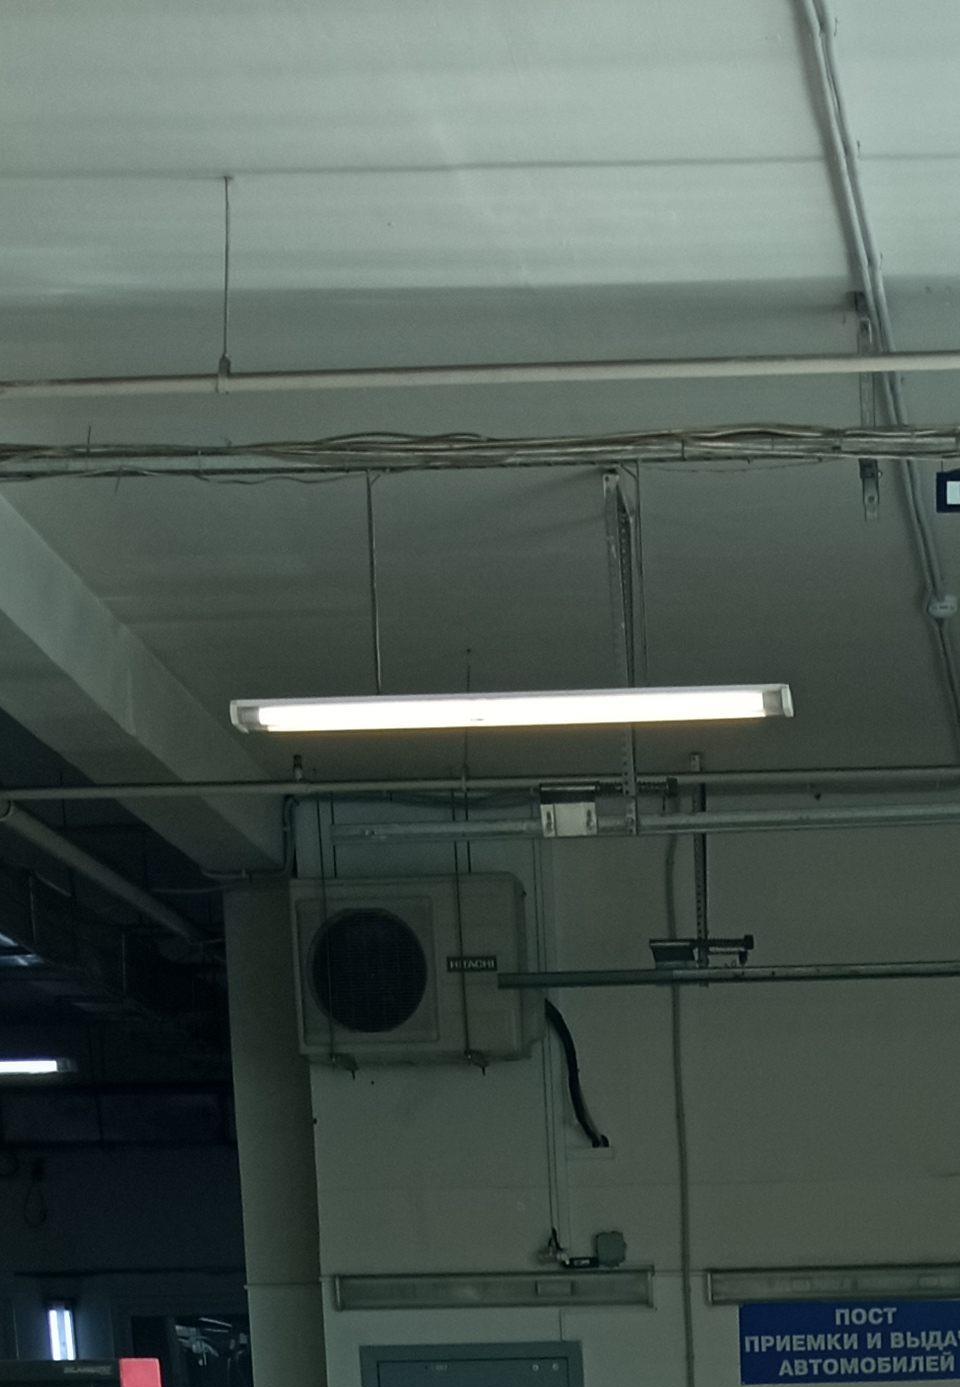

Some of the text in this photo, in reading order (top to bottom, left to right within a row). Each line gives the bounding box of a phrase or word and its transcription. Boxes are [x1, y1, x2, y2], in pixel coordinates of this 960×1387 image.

[835, 1307, 897, 1326] ПОСТ
[745, 1333, 858, 1352] ПРИЕМКИ
[867, 1332, 882, 1349] И
[778, 1351, 955, 1377] АВТОМОБИЛЕЙ
